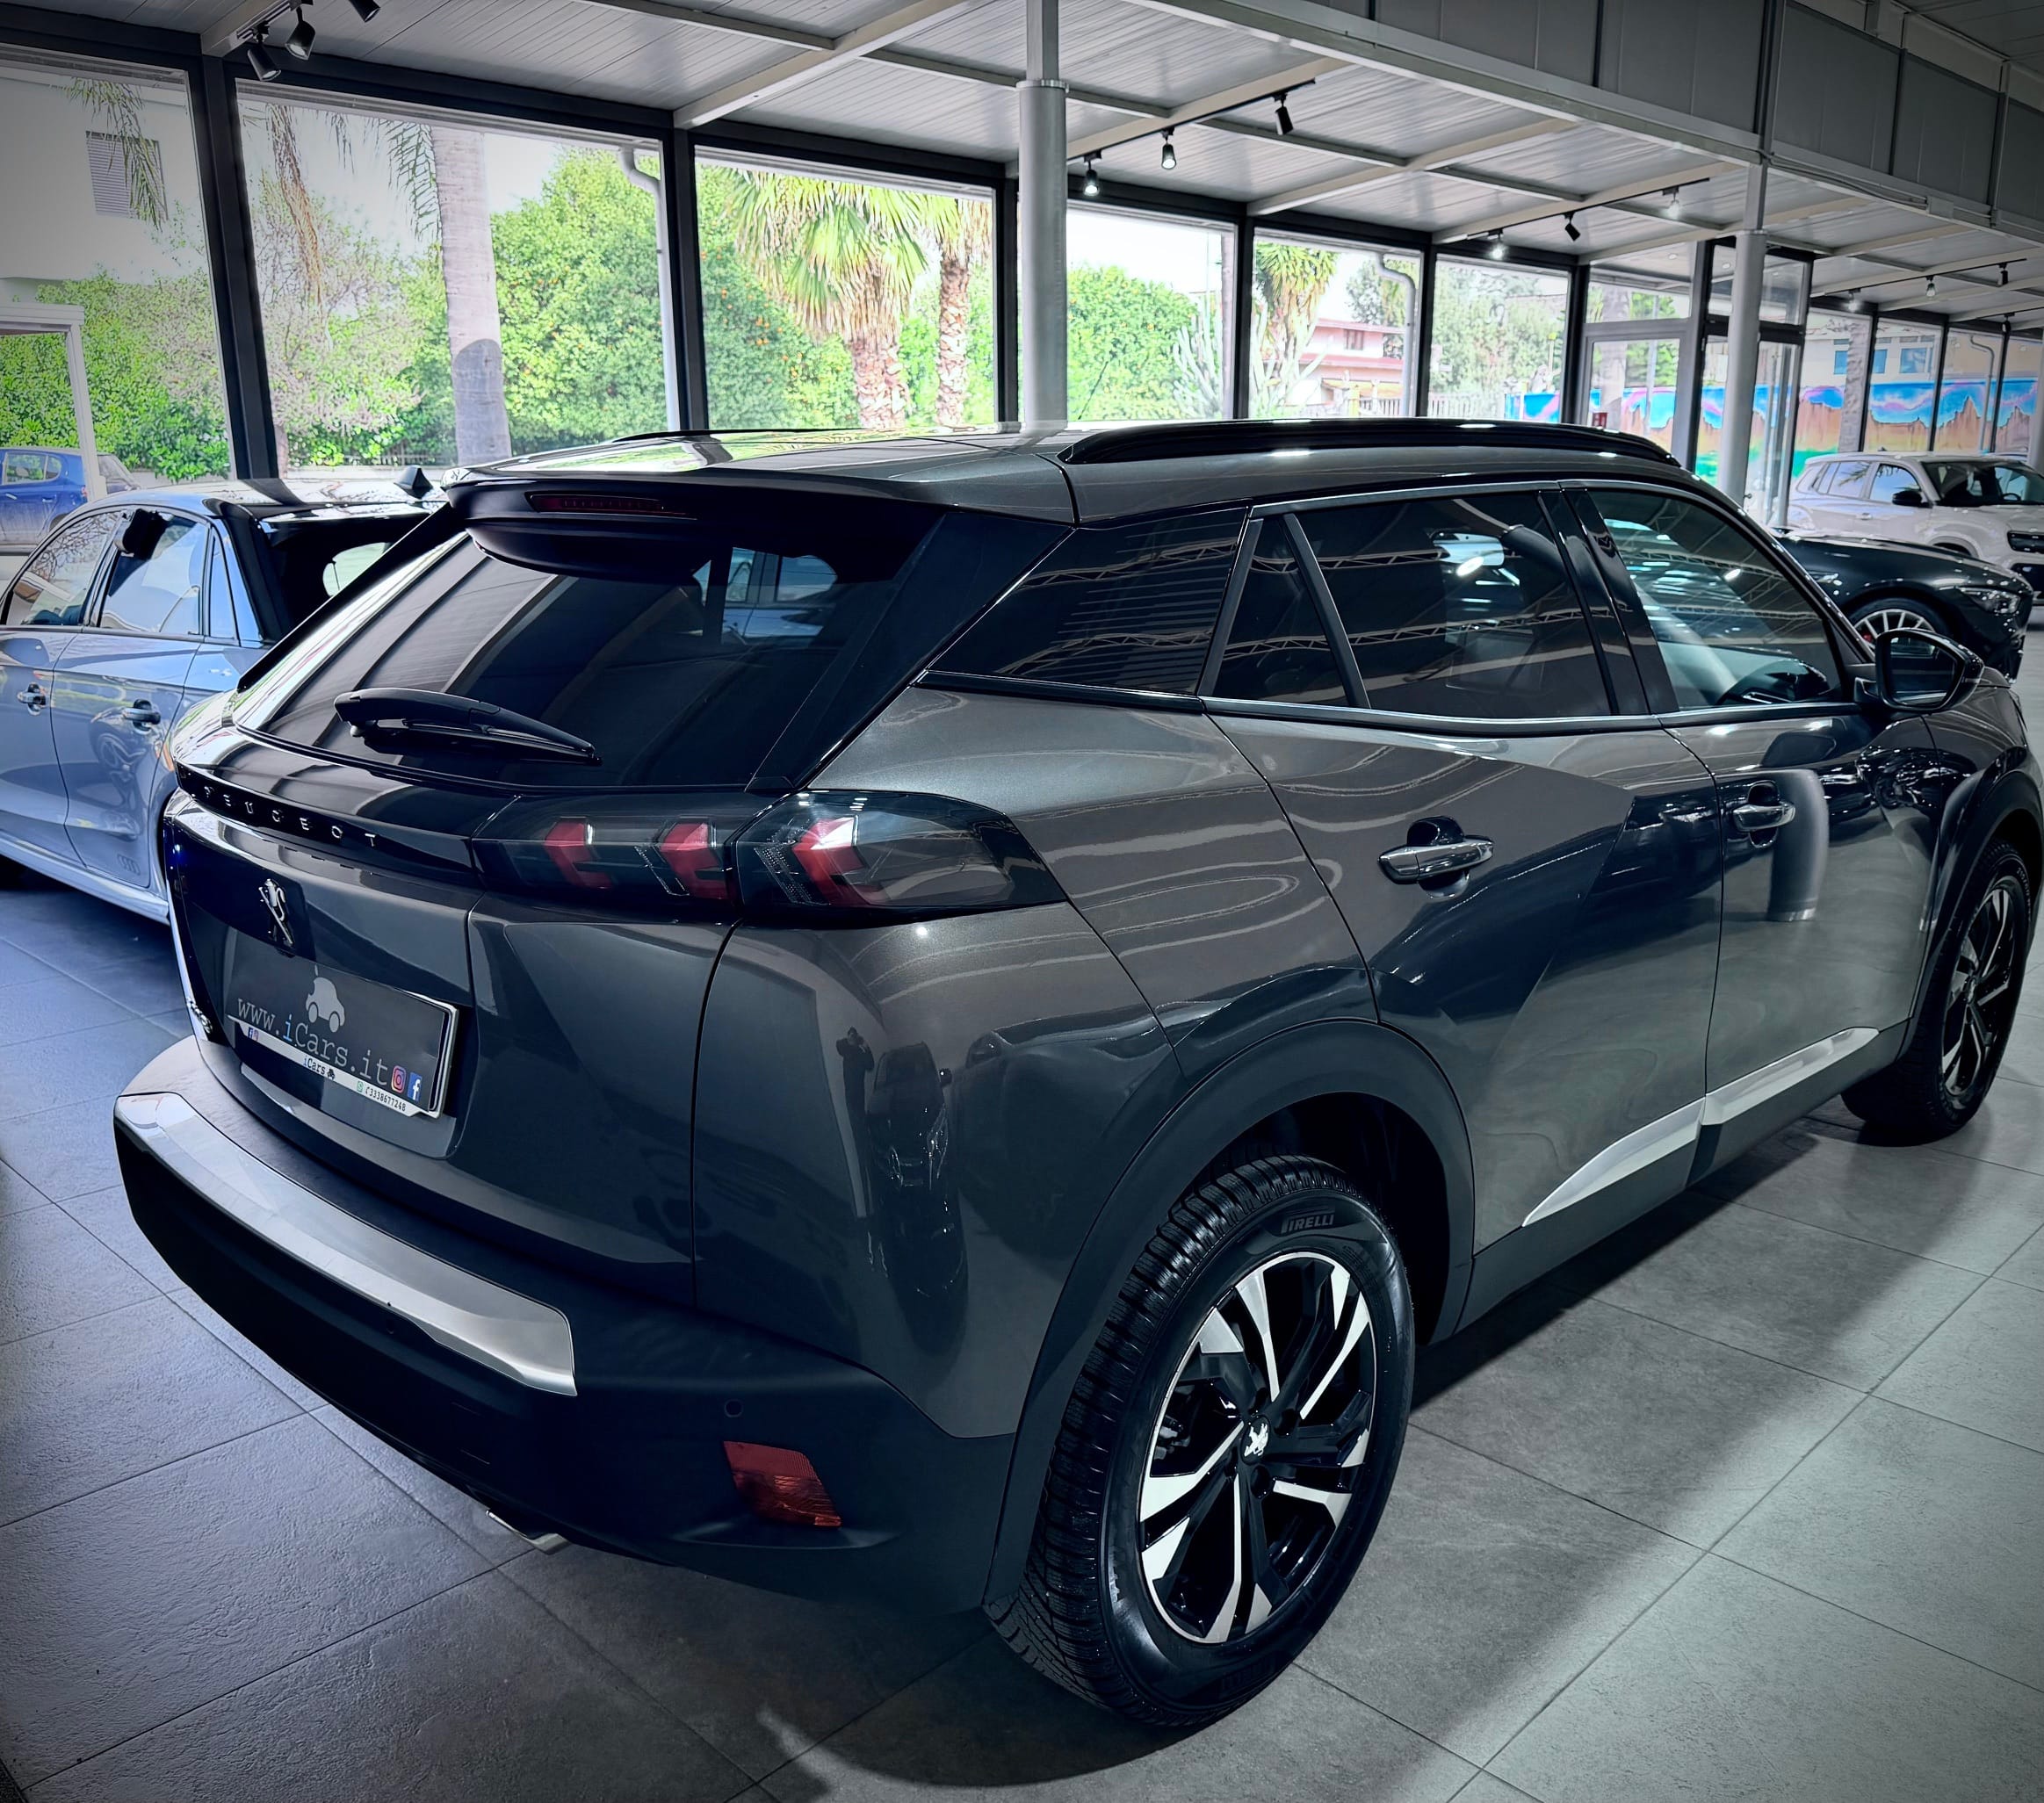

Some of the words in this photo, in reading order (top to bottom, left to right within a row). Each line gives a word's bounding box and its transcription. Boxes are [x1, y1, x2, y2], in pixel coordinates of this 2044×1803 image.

[204, 786, 378, 847] PEUGEOT
[237, 999, 388, 1085] www.iCars.it
[303, 1055, 326, 1076] iCars
[1281, 1214, 1334, 1234] PIRELLI
